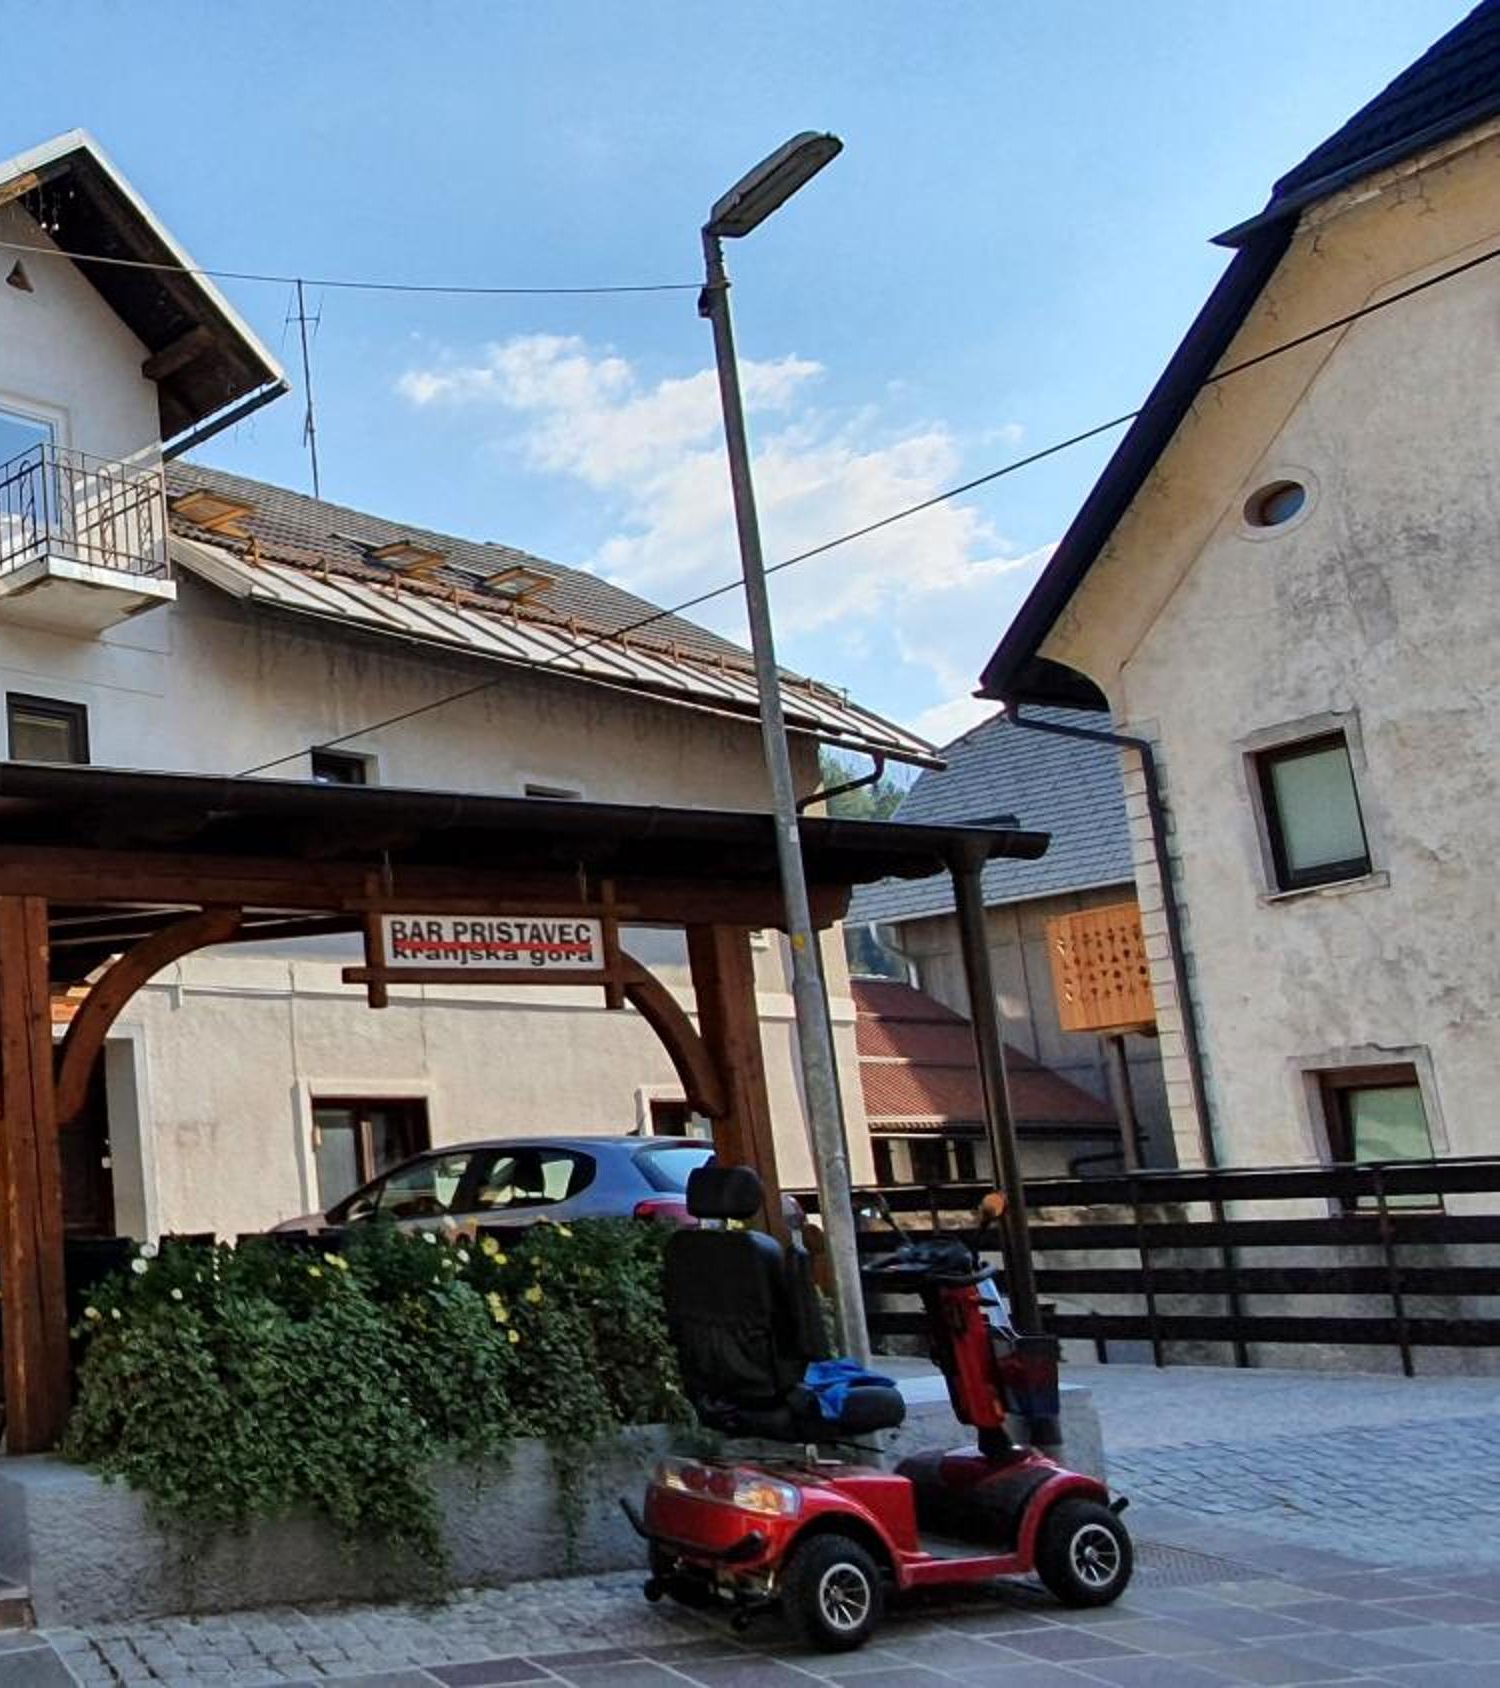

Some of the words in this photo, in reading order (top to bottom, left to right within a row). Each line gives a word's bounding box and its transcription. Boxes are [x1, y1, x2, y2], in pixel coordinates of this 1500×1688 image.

[390, 920, 443, 943] BAR
[453, 921, 592, 945] PRISTAVEC
[392, 945, 519, 965] kranjska
[530, 949, 593, 966] gora
